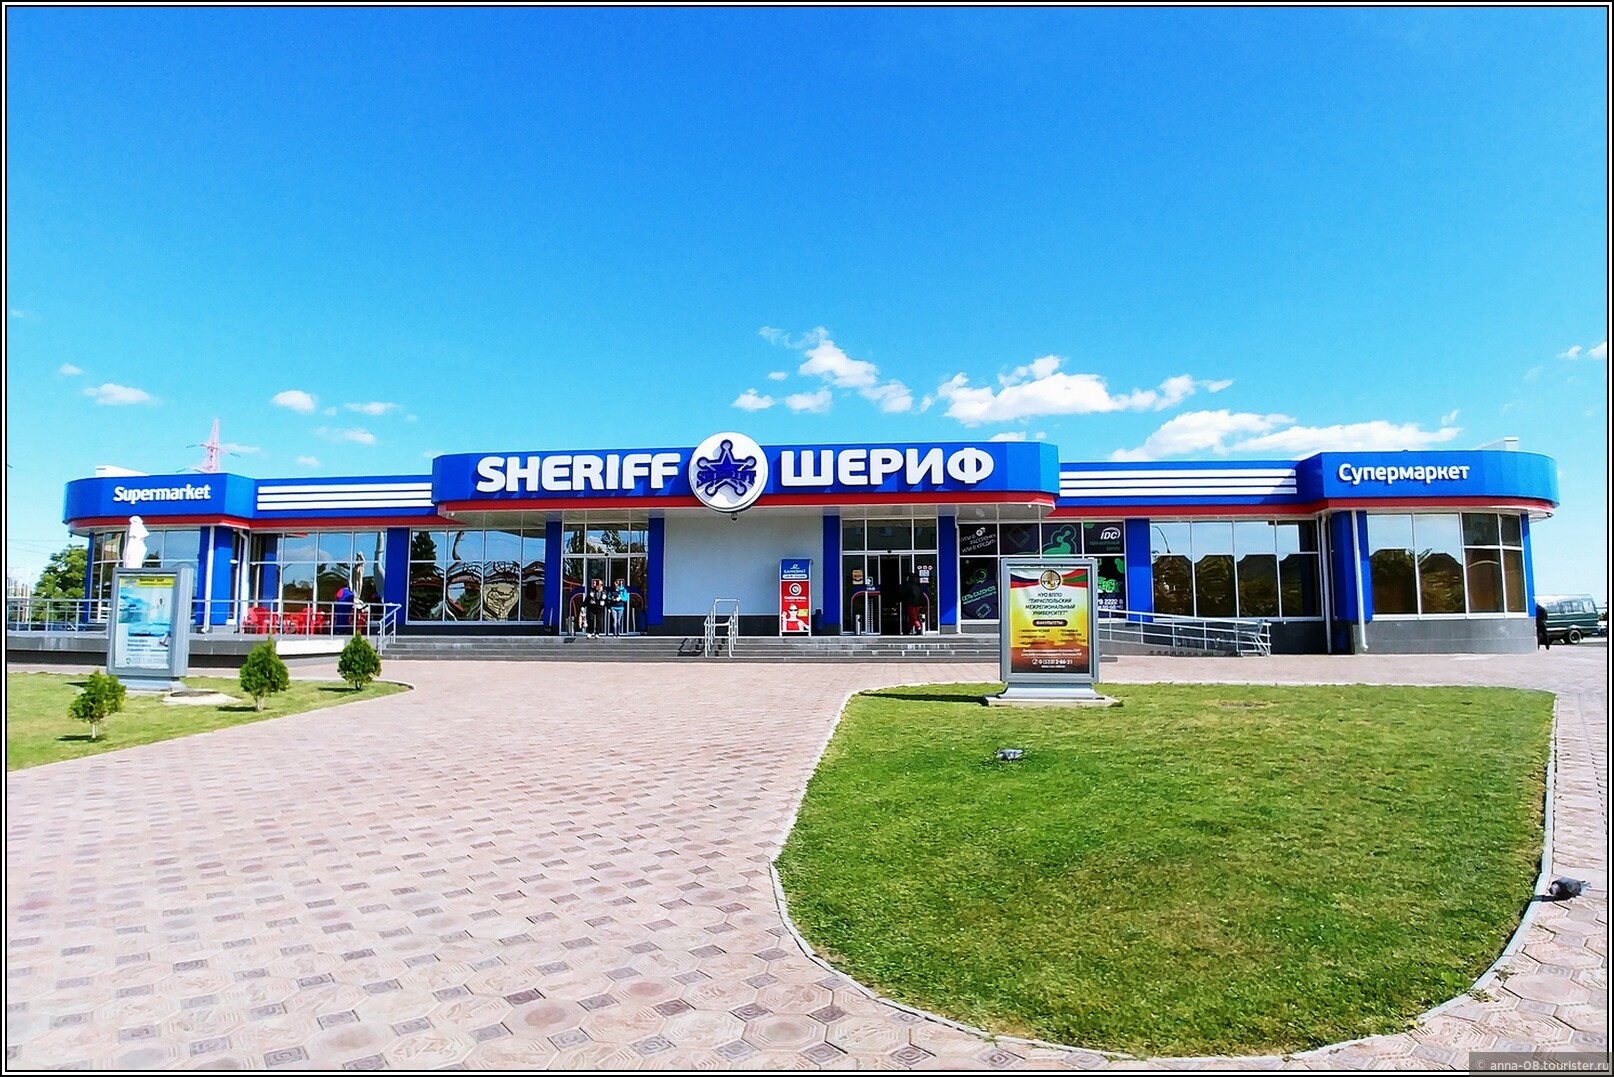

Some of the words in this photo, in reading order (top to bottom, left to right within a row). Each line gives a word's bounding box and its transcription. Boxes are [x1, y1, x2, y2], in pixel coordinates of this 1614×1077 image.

[476, 453, 681, 493] SHERIFF
[781, 447, 995, 487] ШЕРИФ
[1338, 463, 1470, 485] Супермаркет
[113, 483, 211, 505] Supermarket
